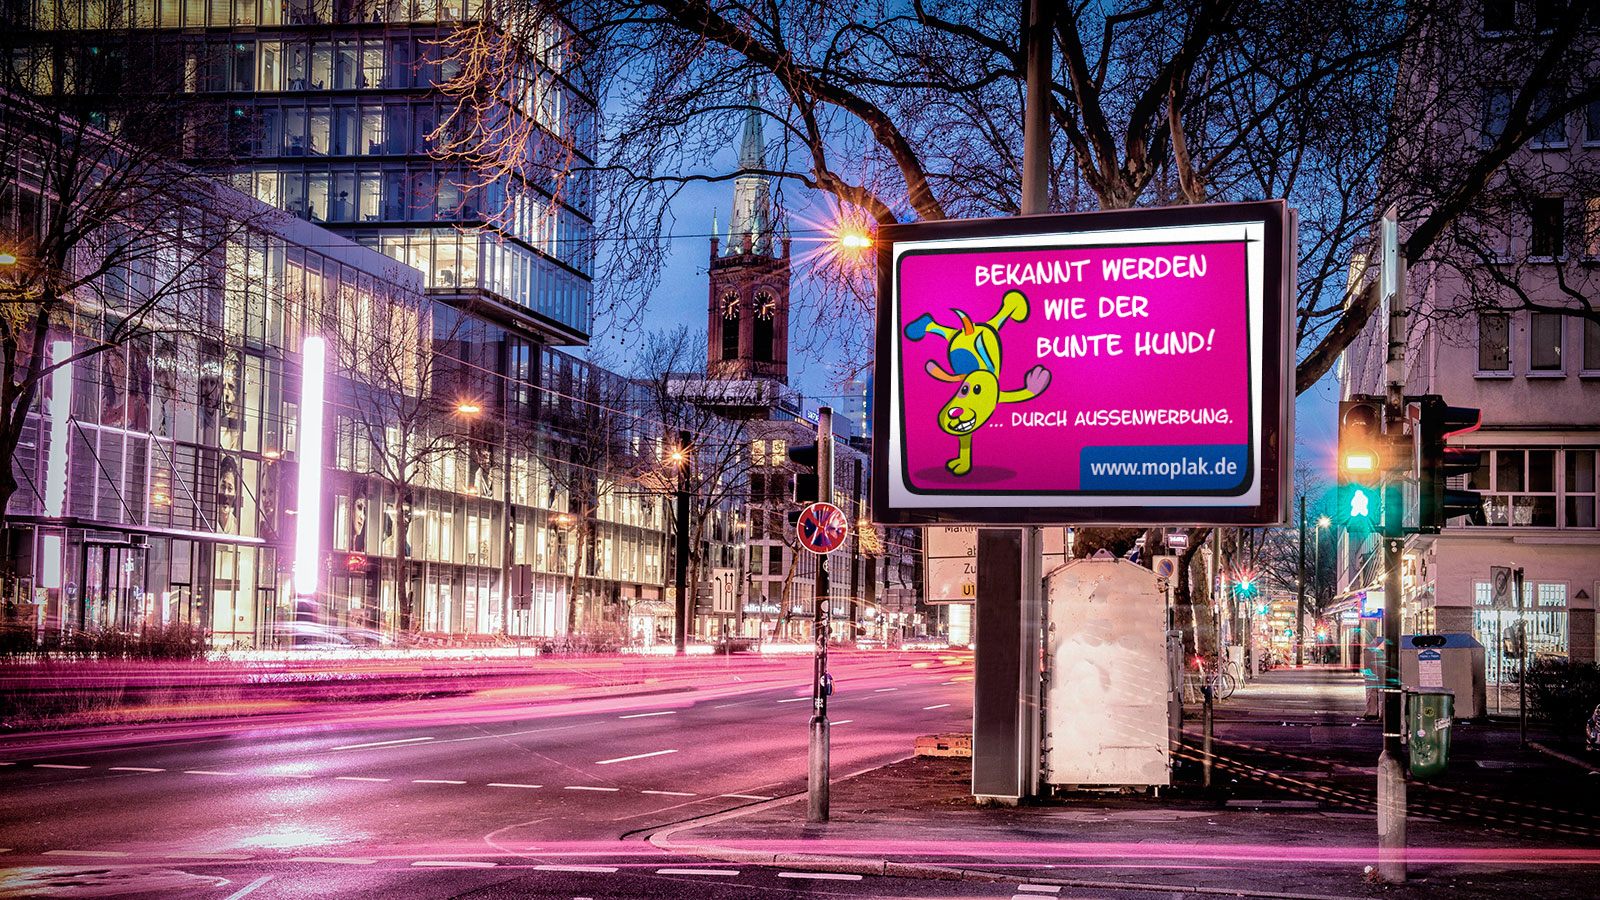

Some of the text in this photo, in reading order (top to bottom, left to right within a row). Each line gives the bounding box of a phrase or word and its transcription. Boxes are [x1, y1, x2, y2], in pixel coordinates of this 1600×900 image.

[975, 254, 1207, 287] BEKANNT WERDEN
[1043, 295, 1149, 322] WIE DER
[1036, 328, 1216, 359] BUNTE HUND!
[1011, 410, 1068, 428] DURCH
[1074, 408, 1233, 427] AUSSENWERBUNG.
[1090, 456, 1238, 480] www.moplak.de
